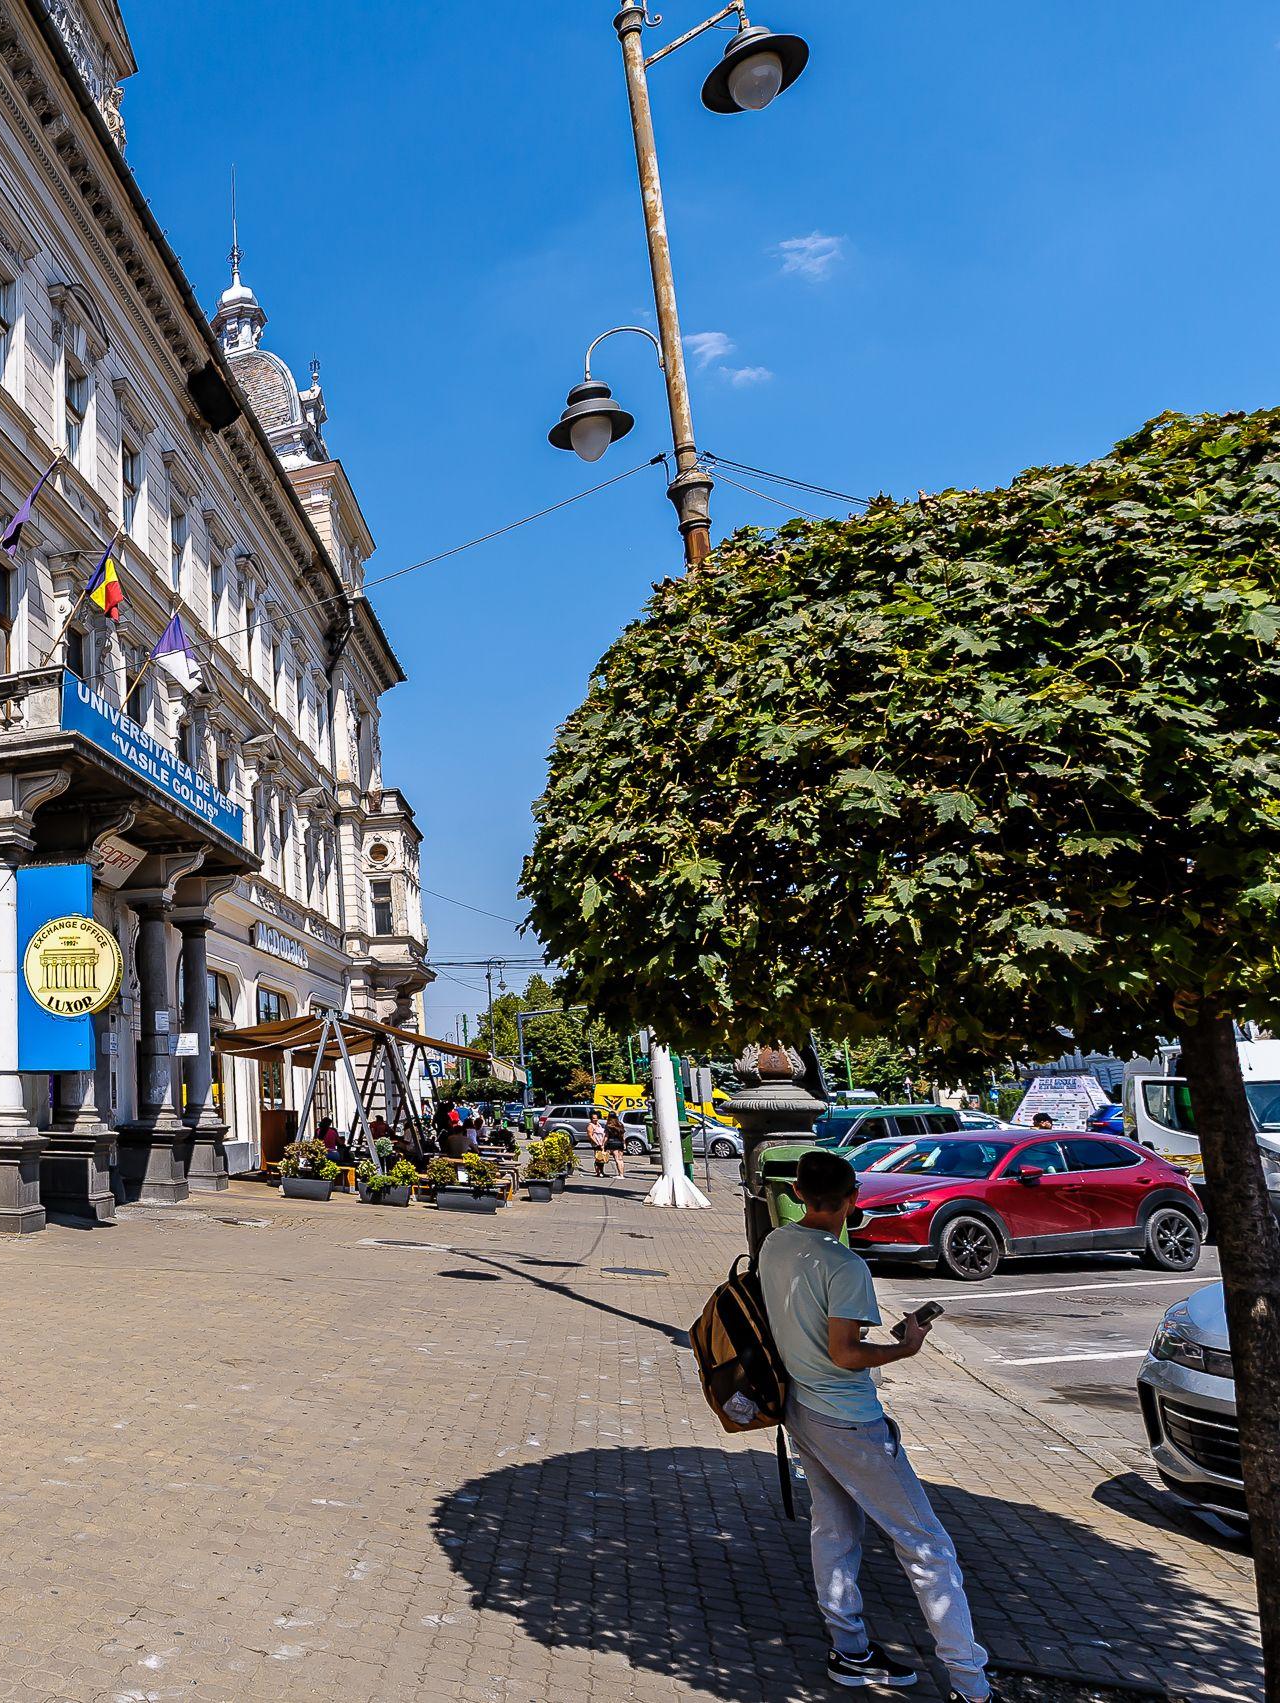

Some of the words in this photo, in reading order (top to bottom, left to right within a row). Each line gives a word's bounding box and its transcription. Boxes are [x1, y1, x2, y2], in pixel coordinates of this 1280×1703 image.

[77, 682, 193, 783] UNIVERSITATEA
[195, 772, 210, 796] DE
[212, 785, 239, 817] VEST
[33, 921, 78, 950] EXCHANGE
[80, 922, 108, 949] OFFICE
[47, 996, 94, 1012] LUXOR
